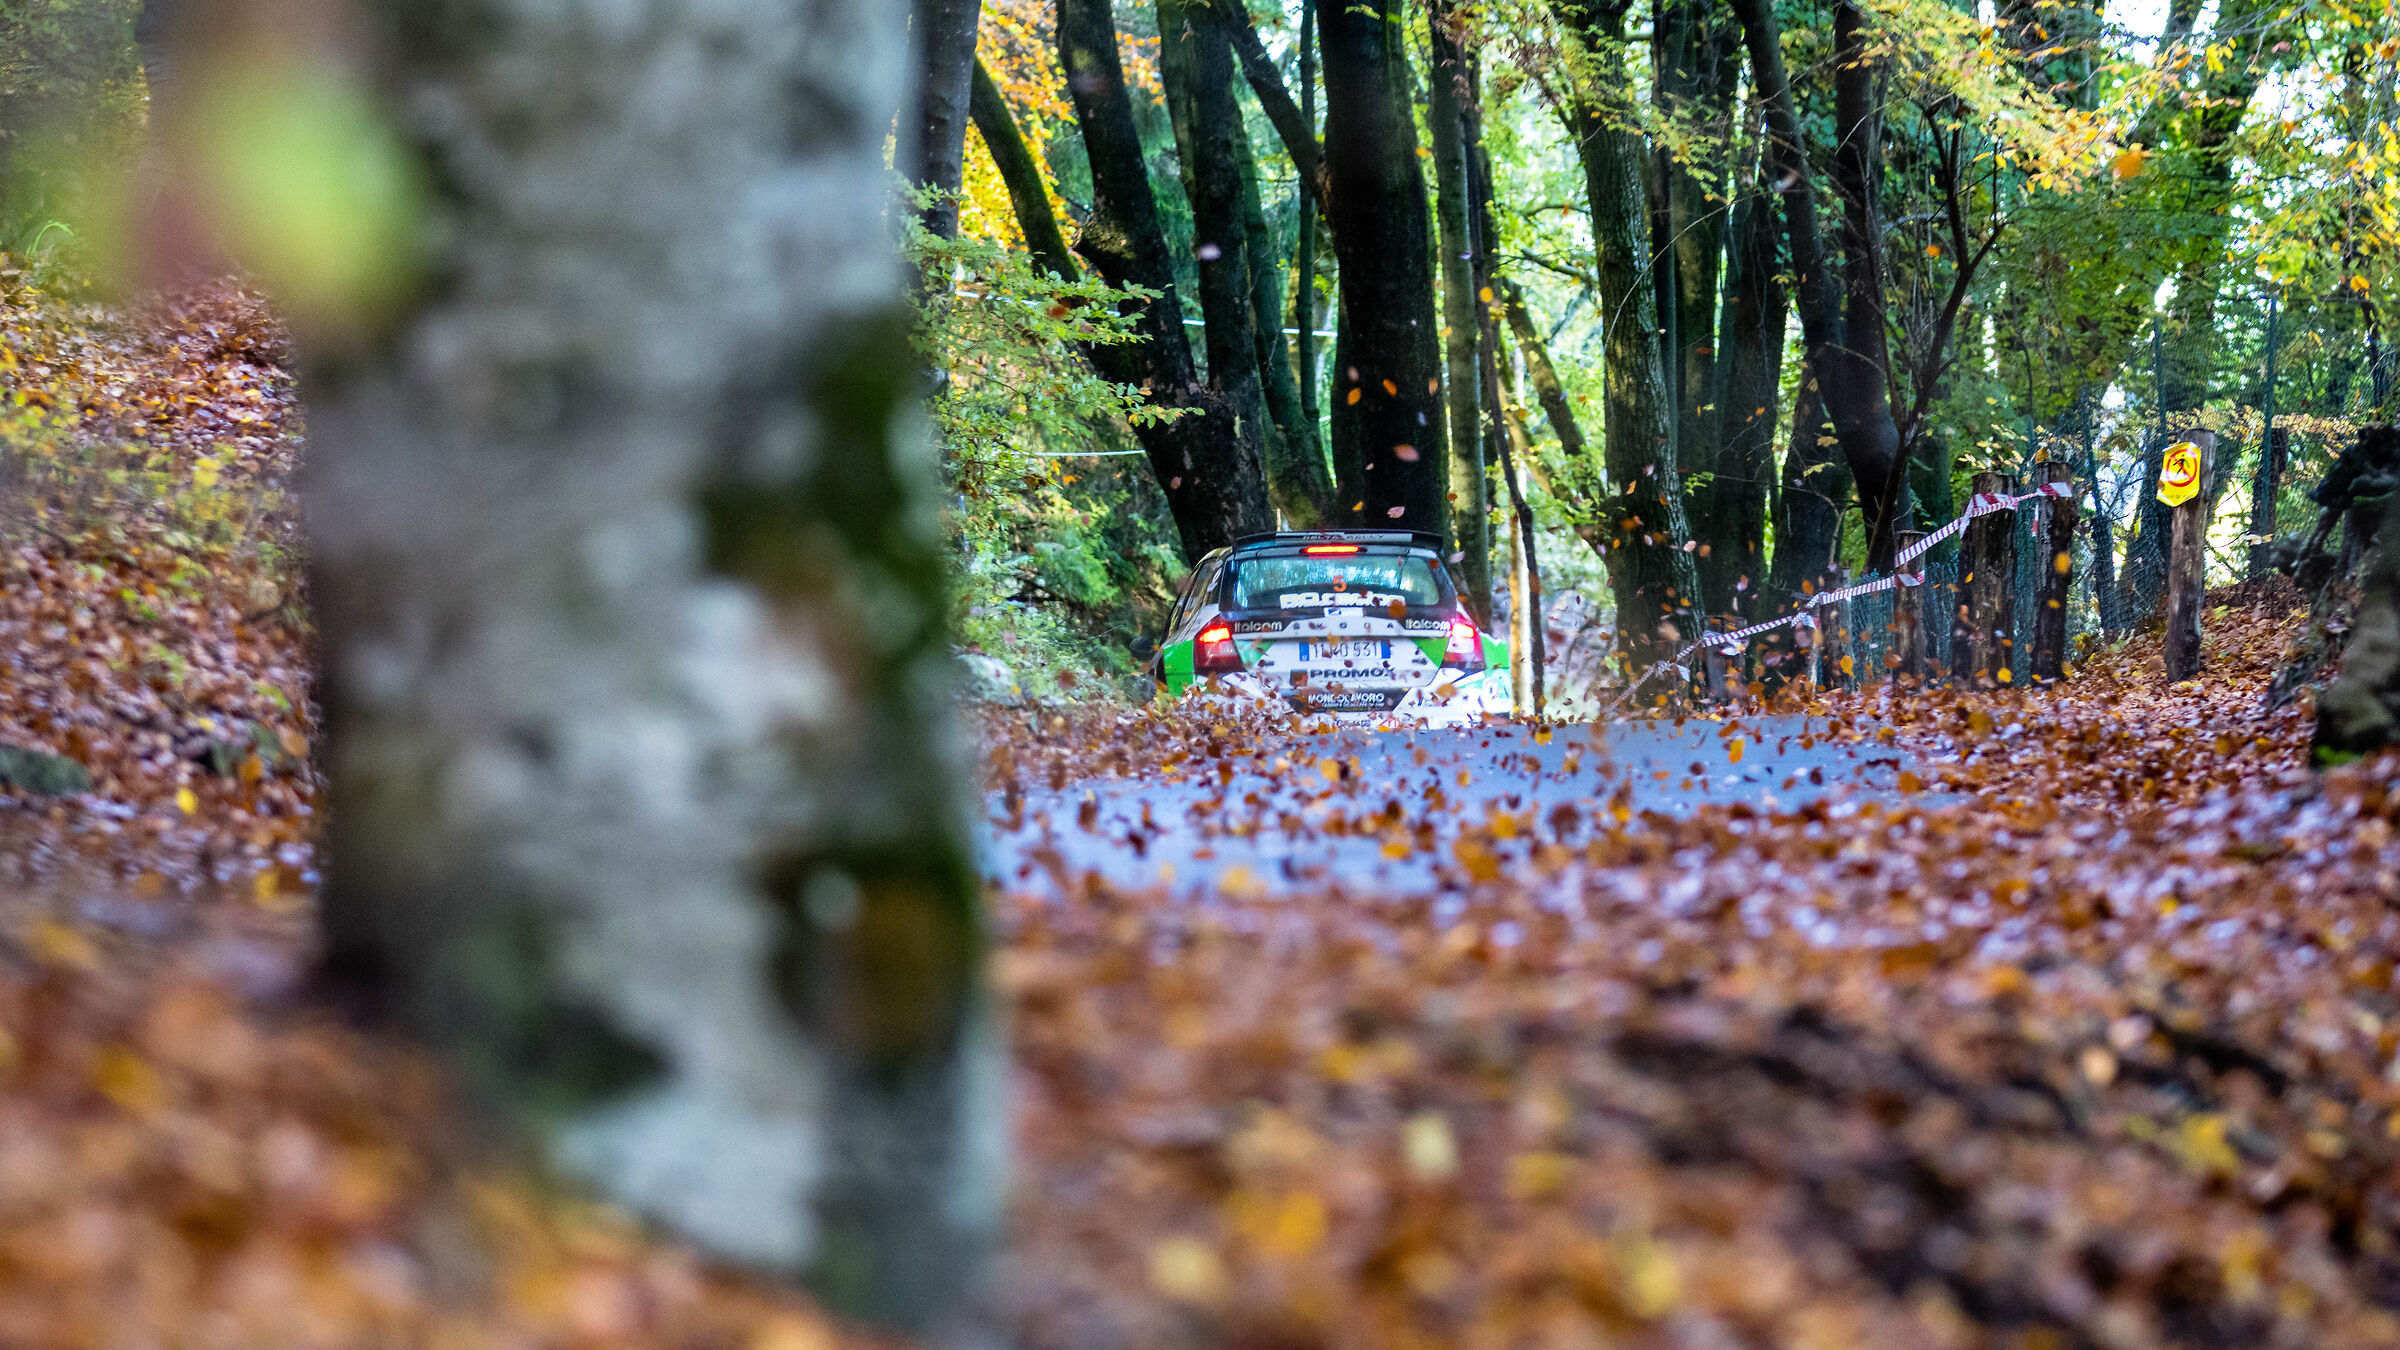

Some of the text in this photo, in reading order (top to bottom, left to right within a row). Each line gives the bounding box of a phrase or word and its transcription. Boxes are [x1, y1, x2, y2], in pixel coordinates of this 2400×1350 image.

[1333, 575, 1347, 592] 5
[1234, 620, 1283, 633] Italcom
[1405, 618, 1451, 631] Italcom
